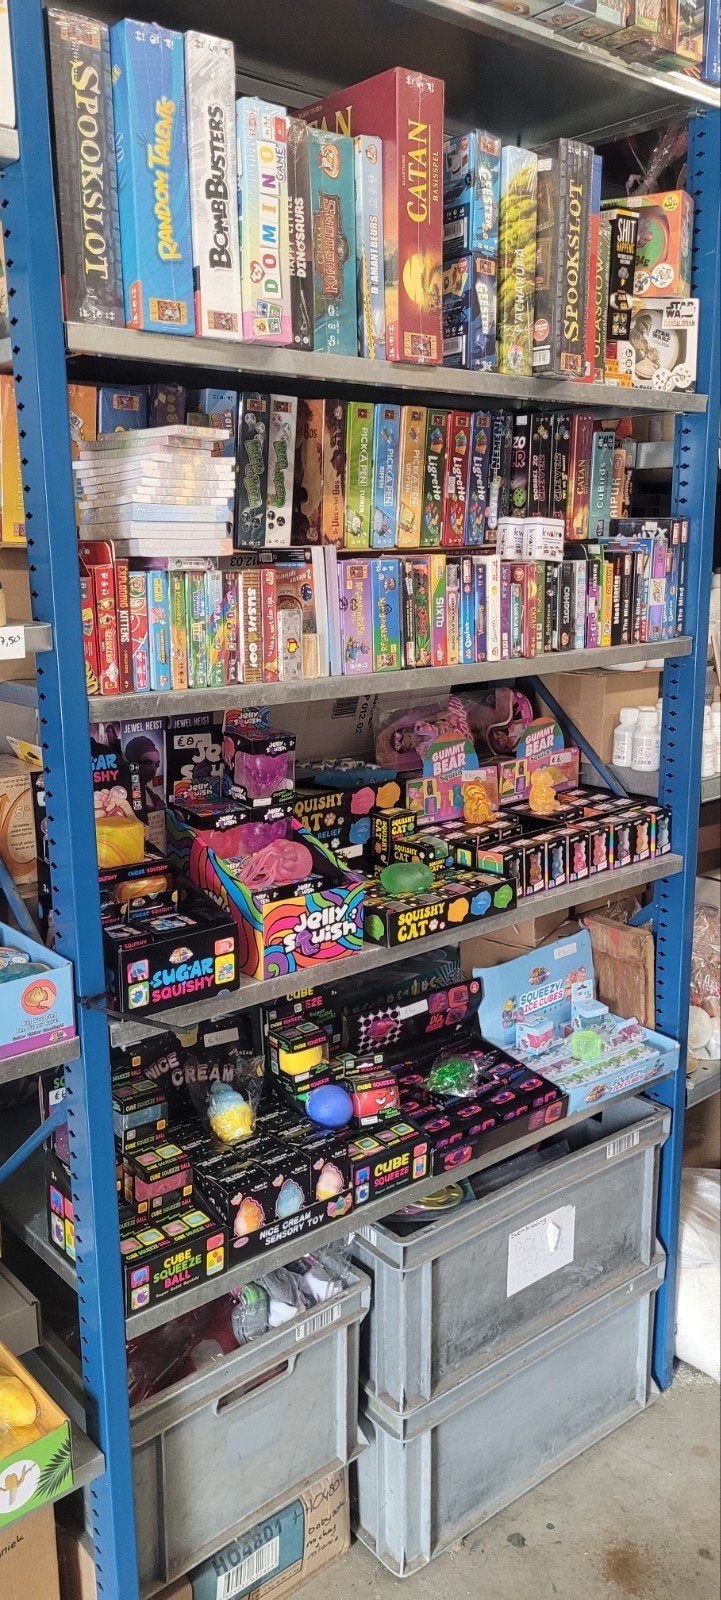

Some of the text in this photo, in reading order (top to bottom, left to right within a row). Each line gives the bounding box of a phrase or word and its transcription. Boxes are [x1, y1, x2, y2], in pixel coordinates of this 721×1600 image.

[72, 62, 108, 281] SPOOKSLOT
[407, 119, 428, 223] CATAN
[154, 170, 181, 262] RANDOM
[295, 197, 306, 278] DINOSAURS
[618, 218, 637, 244] SHIT
[323, 198, 339, 293] KINGDOMS
[564, 179, 582, 342] SPOOKSLOT
[360, 427, 368, 451] PICK
[412, 449, 420, 472] PICK
[359, 465, 367, 484] PEN
[428, 455, 441, 501] Ligretto
[453, 457, 465, 501] Ligretto
[473, 456, 485, 501] Ligretto
[576, 459, 586, 495] CATAN
[596, 462, 606, 509] CuBirds
[332, 480, 340, 495] Bos
[385, 485, 393, 505] PEN
[609, 477, 621, 518] AIPUR
[118, 565, 128, 608] EXPLODING
[247, 587, 257, 632] SUSHI
[436, 597, 444, 627] SIXTO
[120, 610, 129, 643] KITTENS
[124, 720, 163, 734] JEWEL HEIST
[173, 716, 210, 729] JEWEL HEIST
[525, 725, 555, 744] GUMMY
[432, 742, 466, 762] GUMMY
[526, 734, 555, 758] BEAR
[433, 753, 466, 776] BEAR
[294, 792, 344, 817] QUISHY
[392, 816, 415, 827] SQUISHY
[392, 824, 407, 835] CAT
[317, 828, 342, 840] RELIEF
[394, 844, 418, 856] SQUISHY
[394, 851, 409, 862] CAT
[128, 864, 169, 877] SUGAR SQUISHY
[151, 906, 173, 915] SQUISHY
[397, 902, 446, 926] SQUISHY
[124, 939, 148, 949] SQUISHY
[397, 924, 429, 942] CAT
[151, 957, 214, 989] SUGAR
[152, 976, 215, 1003] SQUISHY
[286, 987, 315, 1002] CUBE
[520, 980, 563, 1004] SQUEEZY
[524, 989, 564, 1014] ICE CUBES
[293, 1036, 327, 1050] CUBE SQUEEZE
[145, 1051, 179, 1080] NICE
[171, 1063, 234, 1087] CREAM
[297, 1084, 311, 1092] CUBE
[372, 1079, 396, 1088] SQUEEZE
[126, 1103, 137, 1112] CUBE
[125, 1142, 136, 1150] CUBE
[149, 1162, 191, 1181] CUBE SQUEEZE BALL
[373, 1153, 410, 1177] CUBE
[373, 1167, 410, 1187] SQUEEZE
[119, 1215, 147, 1229] QUEEZE BALL
[151, 1210, 162, 1218] CUBE
[259, 1211, 312, 1240] NICE CREAM
[264, 1213, 325, 1246] SENSORY TOY
[153, 1254, 202, 1283] SQUEEZE
[163, 1249, 192, 1268] CUBE
[164, 1270, 191, 1289] BALL
